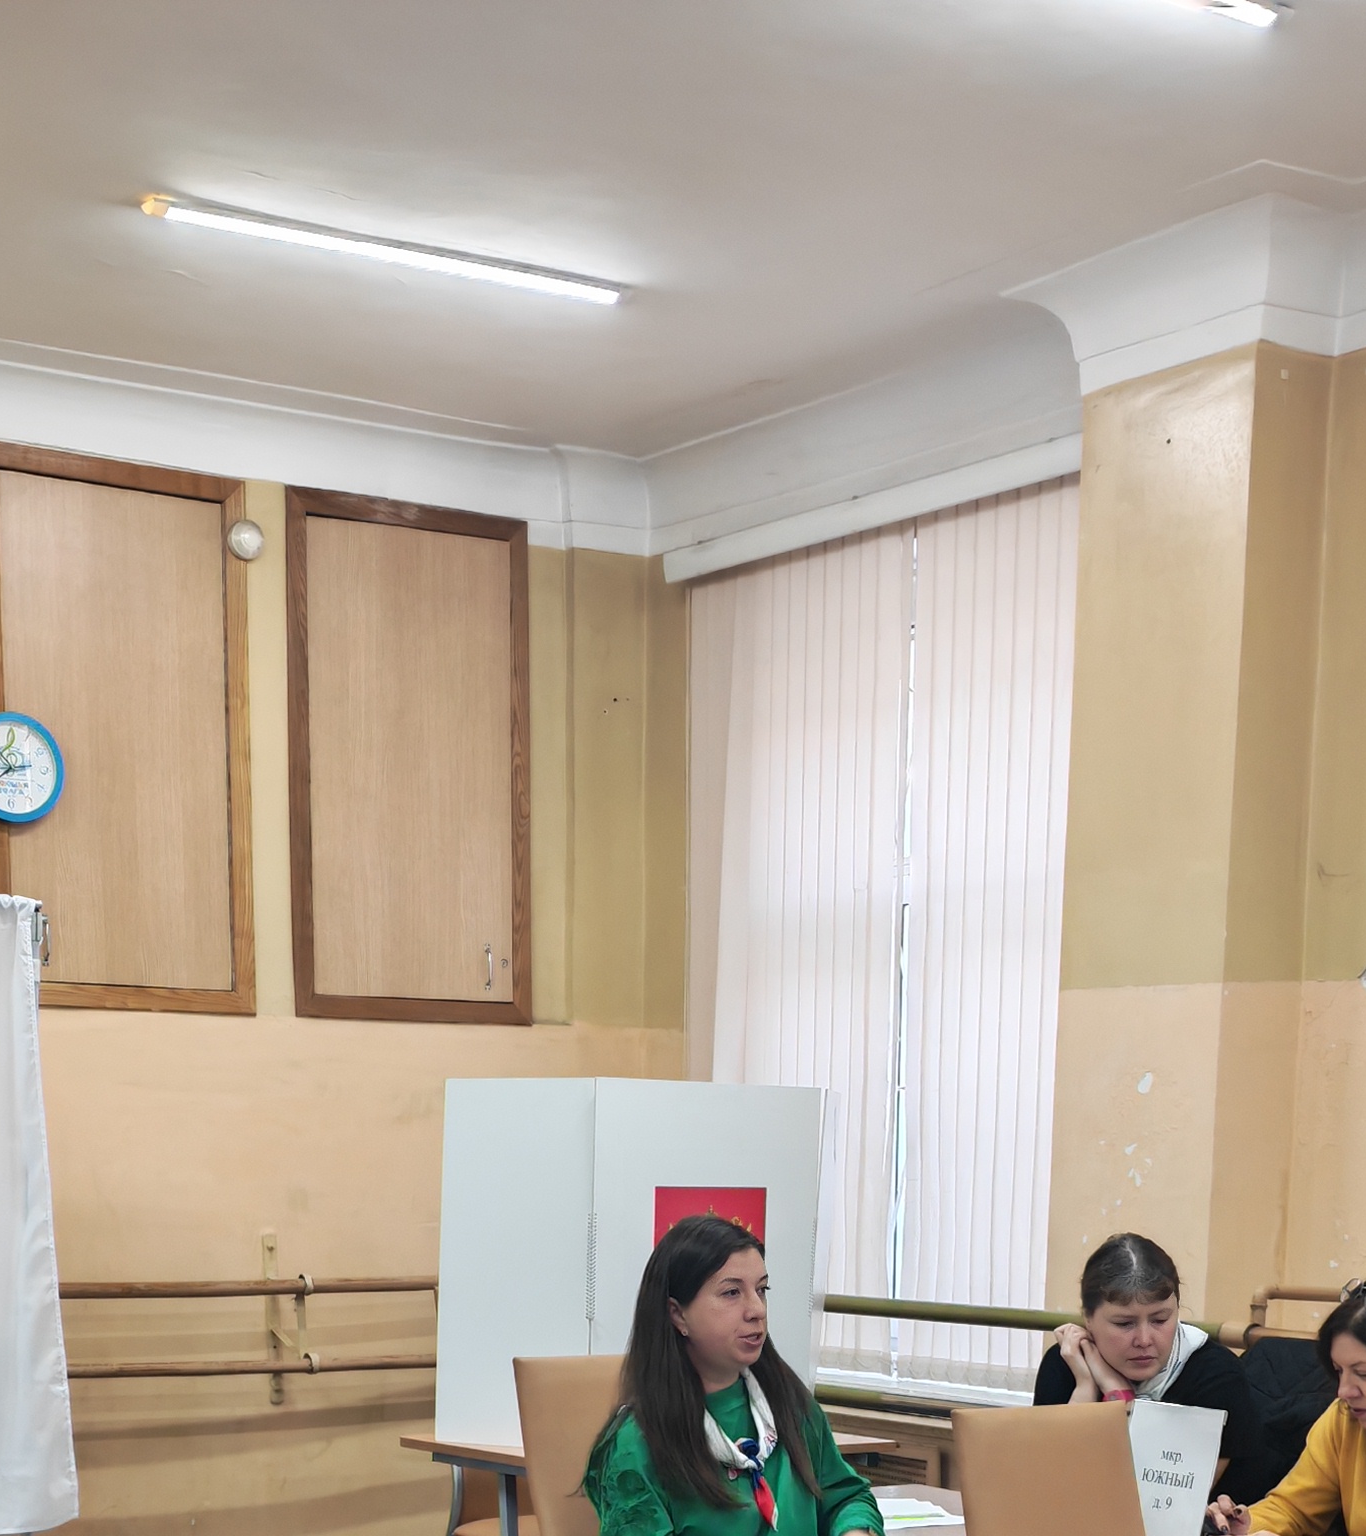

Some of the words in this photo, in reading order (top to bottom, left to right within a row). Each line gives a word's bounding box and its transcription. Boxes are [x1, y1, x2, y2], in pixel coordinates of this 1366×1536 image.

[1160, 1450, 1184, 1465] мкр.
[1142, 1468, 1195, 1489] ЮЖНЫЙ
[1152, 1498, 1162, 1509] д.
[1165, 1496, 1173, 1509] 9
